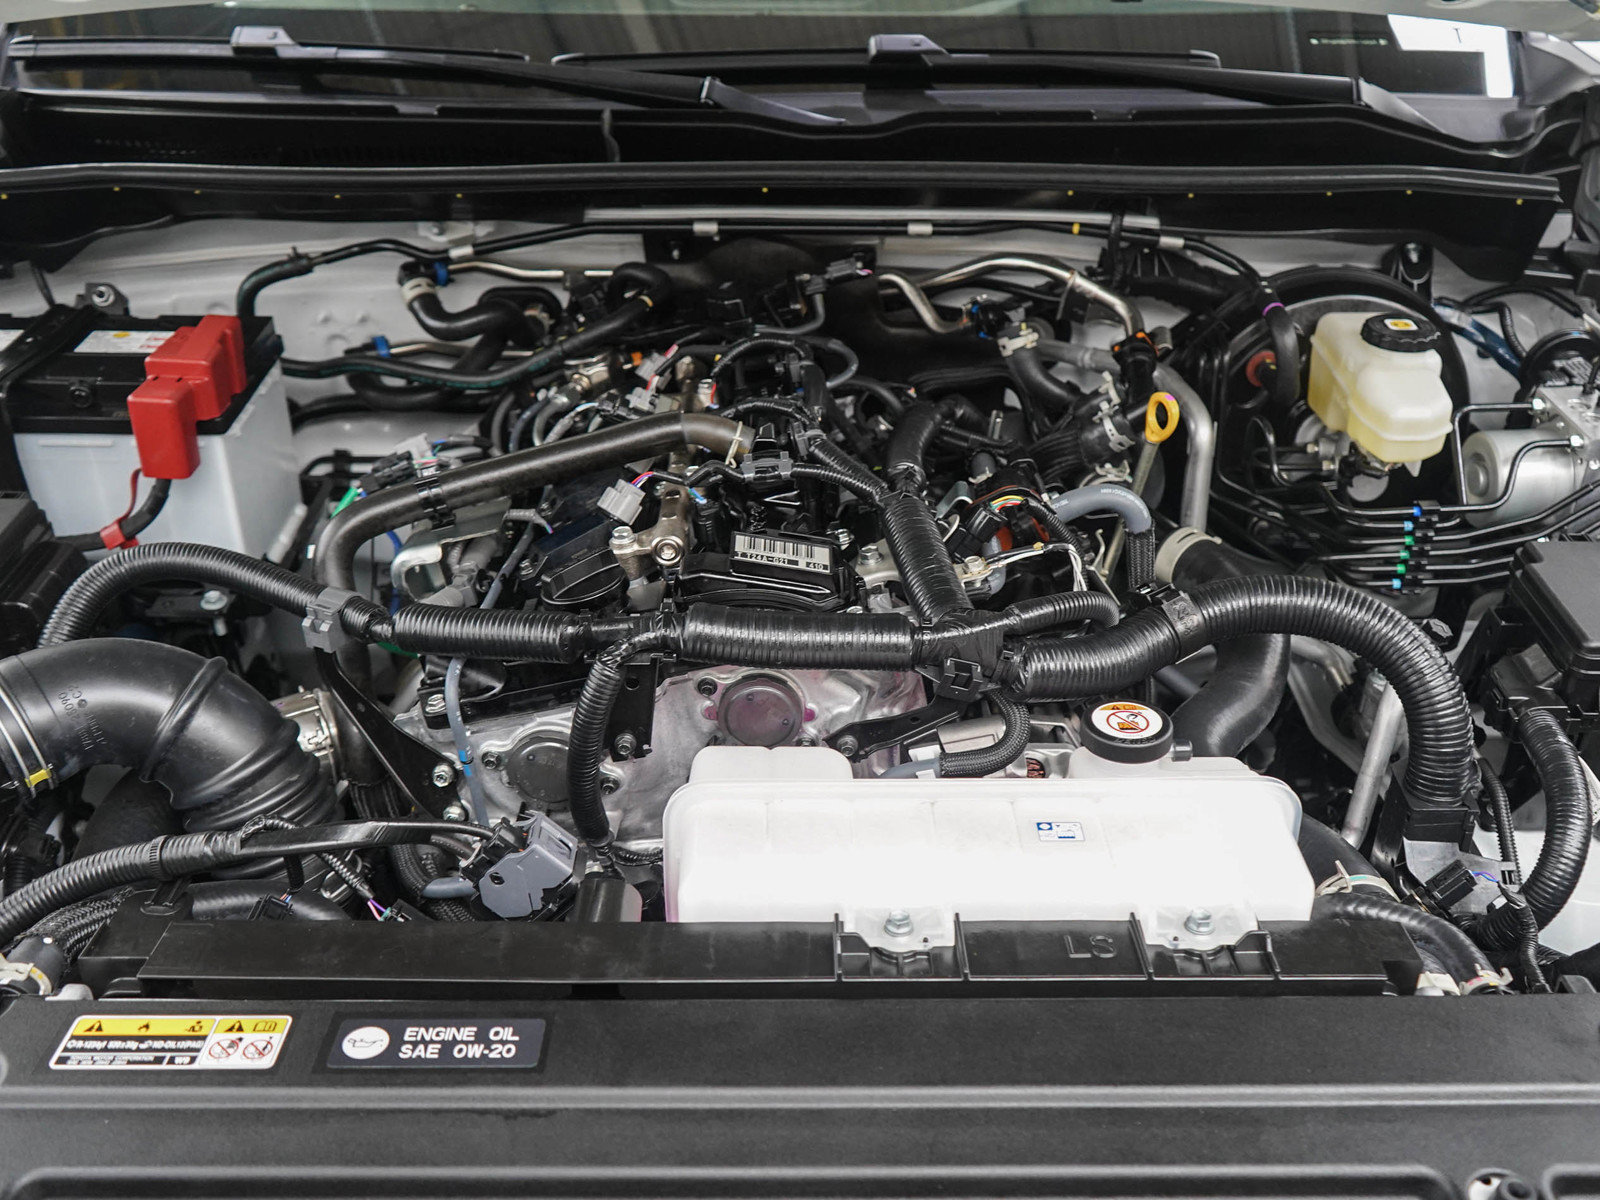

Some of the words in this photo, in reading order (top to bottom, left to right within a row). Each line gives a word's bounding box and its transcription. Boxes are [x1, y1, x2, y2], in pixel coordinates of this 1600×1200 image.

[1063, 934, 1117, 958] LS
[403, 1026, 477, 1041] ENGINE
[488, 1026, 520, 1041] OIL
[398, 1043, 441, 1058] SAE
[453, 1043, 516, 1059] 0W-20
